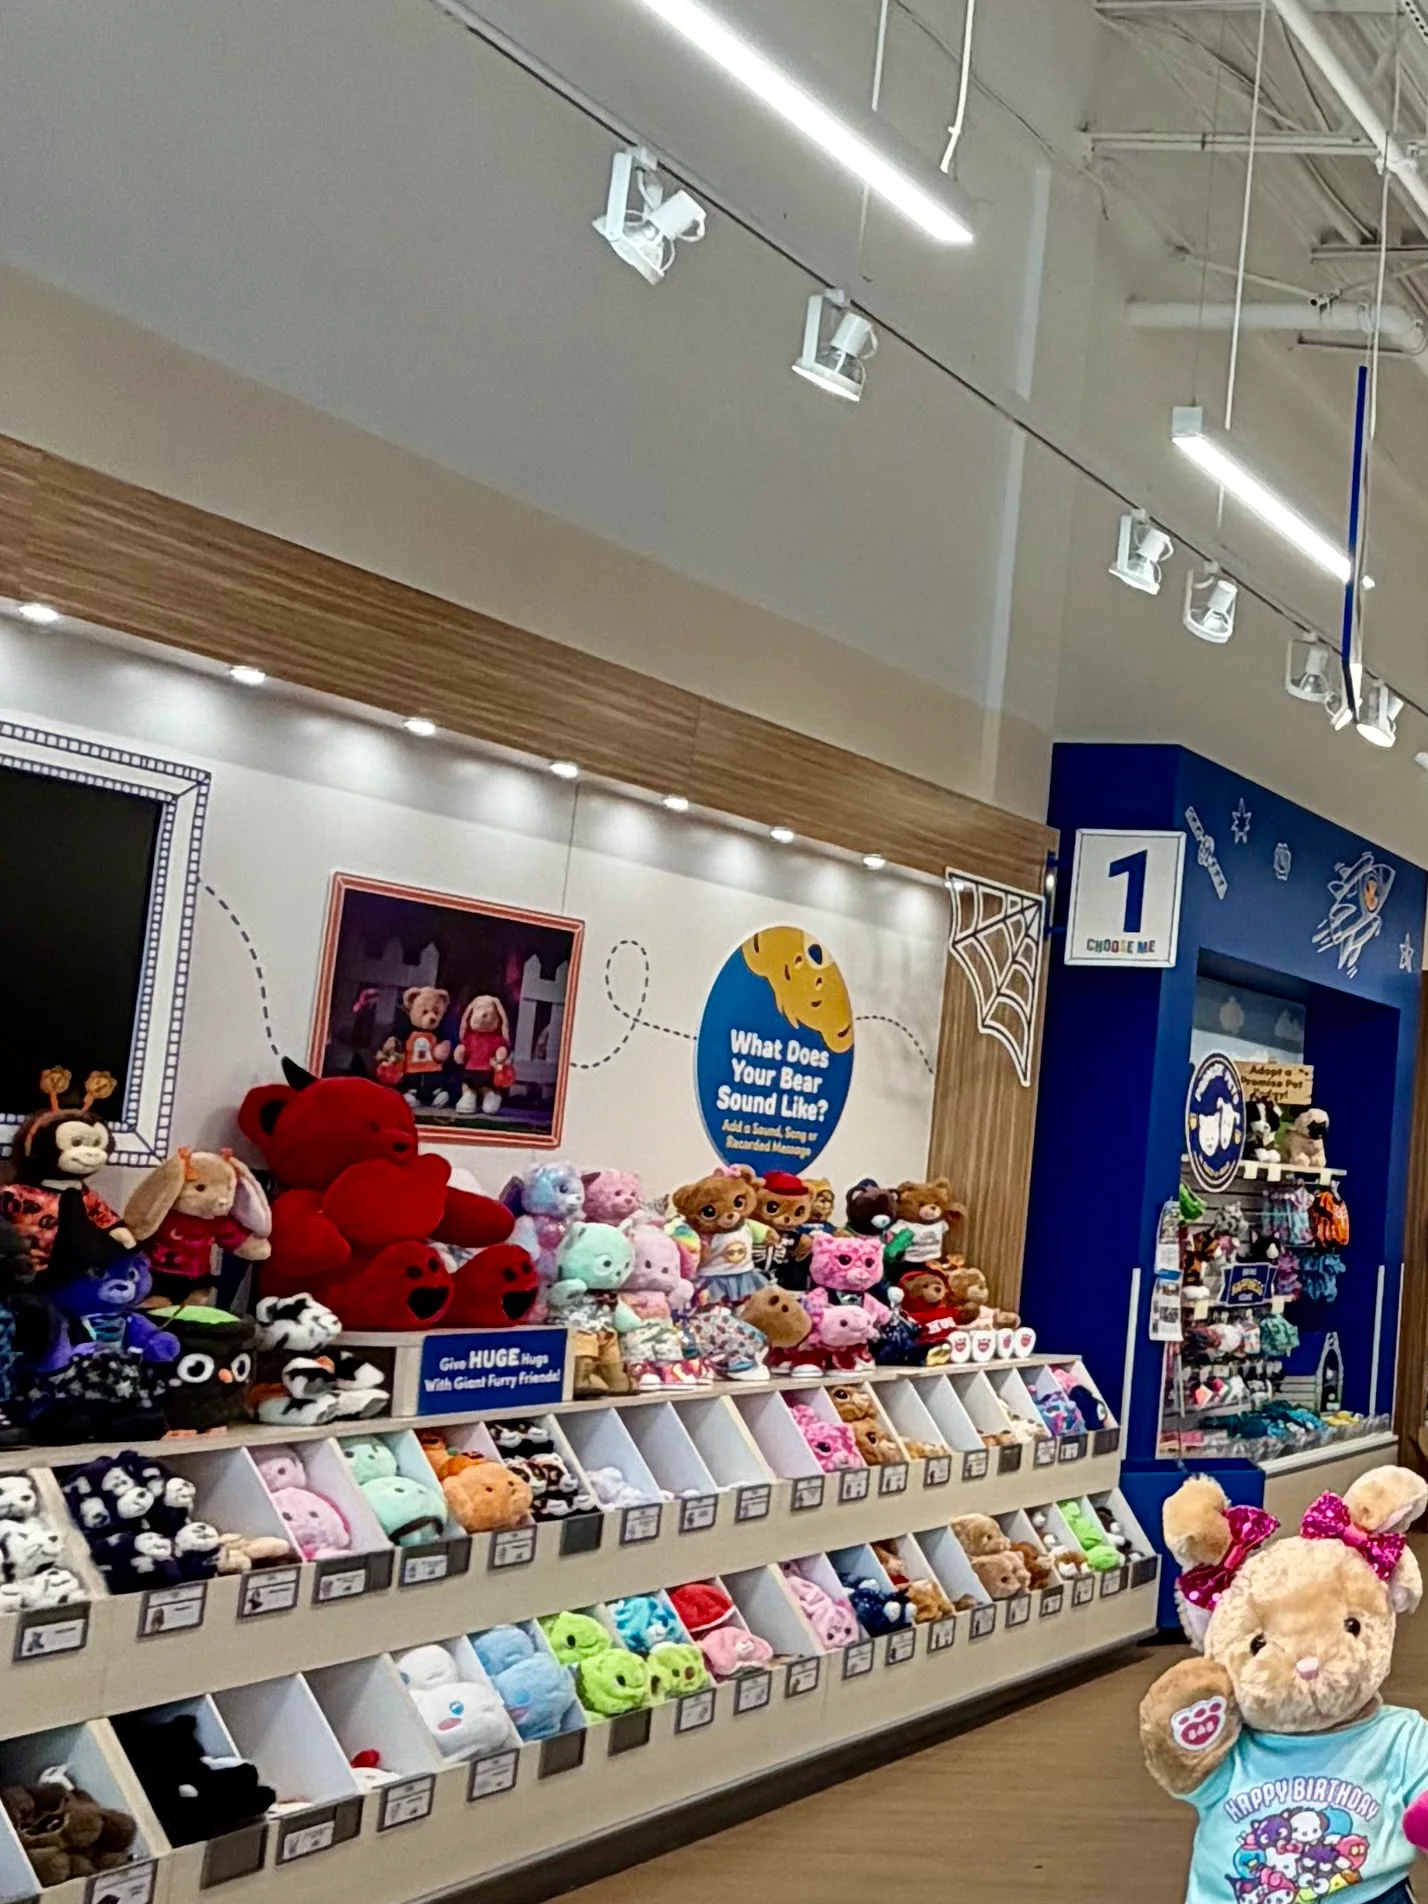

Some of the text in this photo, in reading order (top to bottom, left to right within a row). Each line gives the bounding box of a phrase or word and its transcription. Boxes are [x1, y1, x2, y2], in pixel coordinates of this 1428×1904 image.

[1108, 849, 1148, 933] 1
[1086, 938, 1155, 954] CHOOSE ME
[730, 1029, 829, 1068] What Does
[731, 1058, 823, 1094] Your Bear
[1249, 1064, 1292, 1080] Adopt a
[1285, 1078, 1303, 1089] Pet
[716, 1085, 829, 1122] Sound Like?
[439, 1347, 549, 1371] Give HUGE Hugs
[424, 1369, 561, 1392] With Giant Furry Friends!
[1224, 1776, 1380, 1824] HAPPY BIRTHDAY
